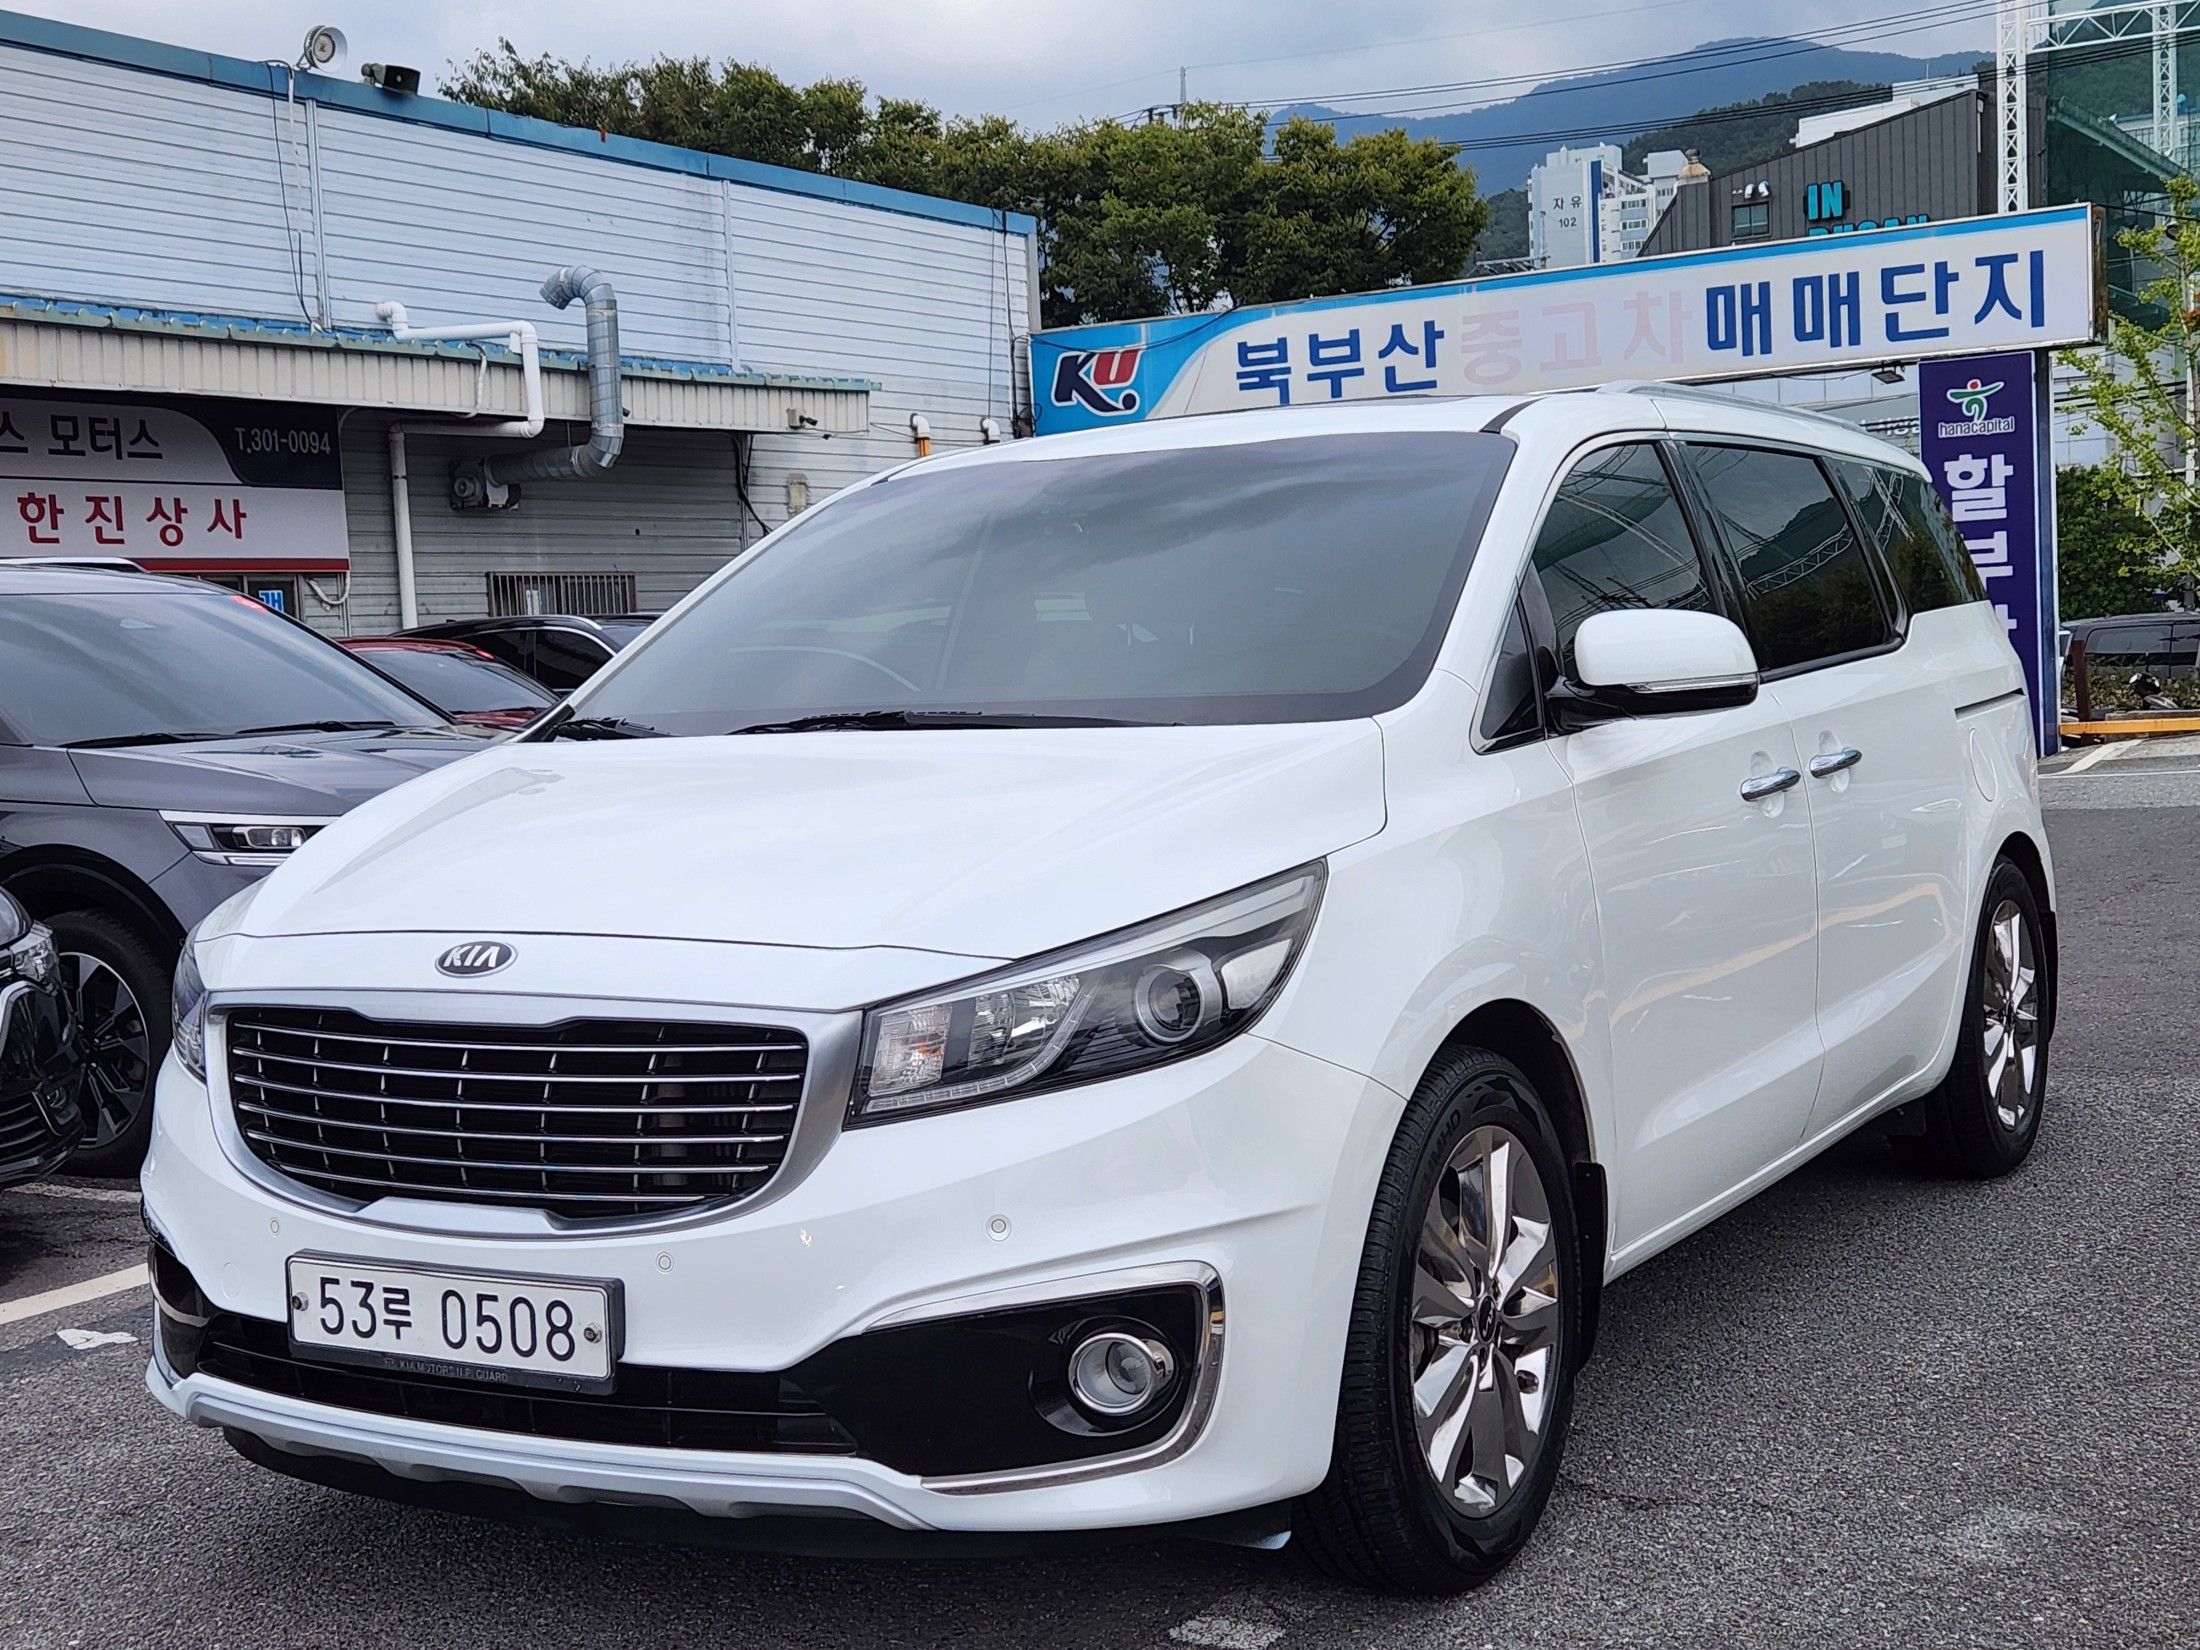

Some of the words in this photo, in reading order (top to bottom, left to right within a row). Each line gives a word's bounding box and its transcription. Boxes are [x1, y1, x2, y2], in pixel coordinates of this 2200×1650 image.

[1558, 216, 1577, 228] 102
[1806, 180, 1845, 222] IN
[1235, 319, 1445, 406] 북부산
[1460, 290, 1694, 386] 중고차
[1705, 249, 2045, 357] 매매단지
[48, 414, 163, 460] 모터스
[234, 427, 331, 455] T.301-0094
[1939, 416, 2015, 437] hanacapital
[16, 491, 247, 547] 한진상사
[443, 945, 501, 968] KIA
[319, 1276, 412, 1341] 53루
[441, 1289, 576, 1362] 0508
